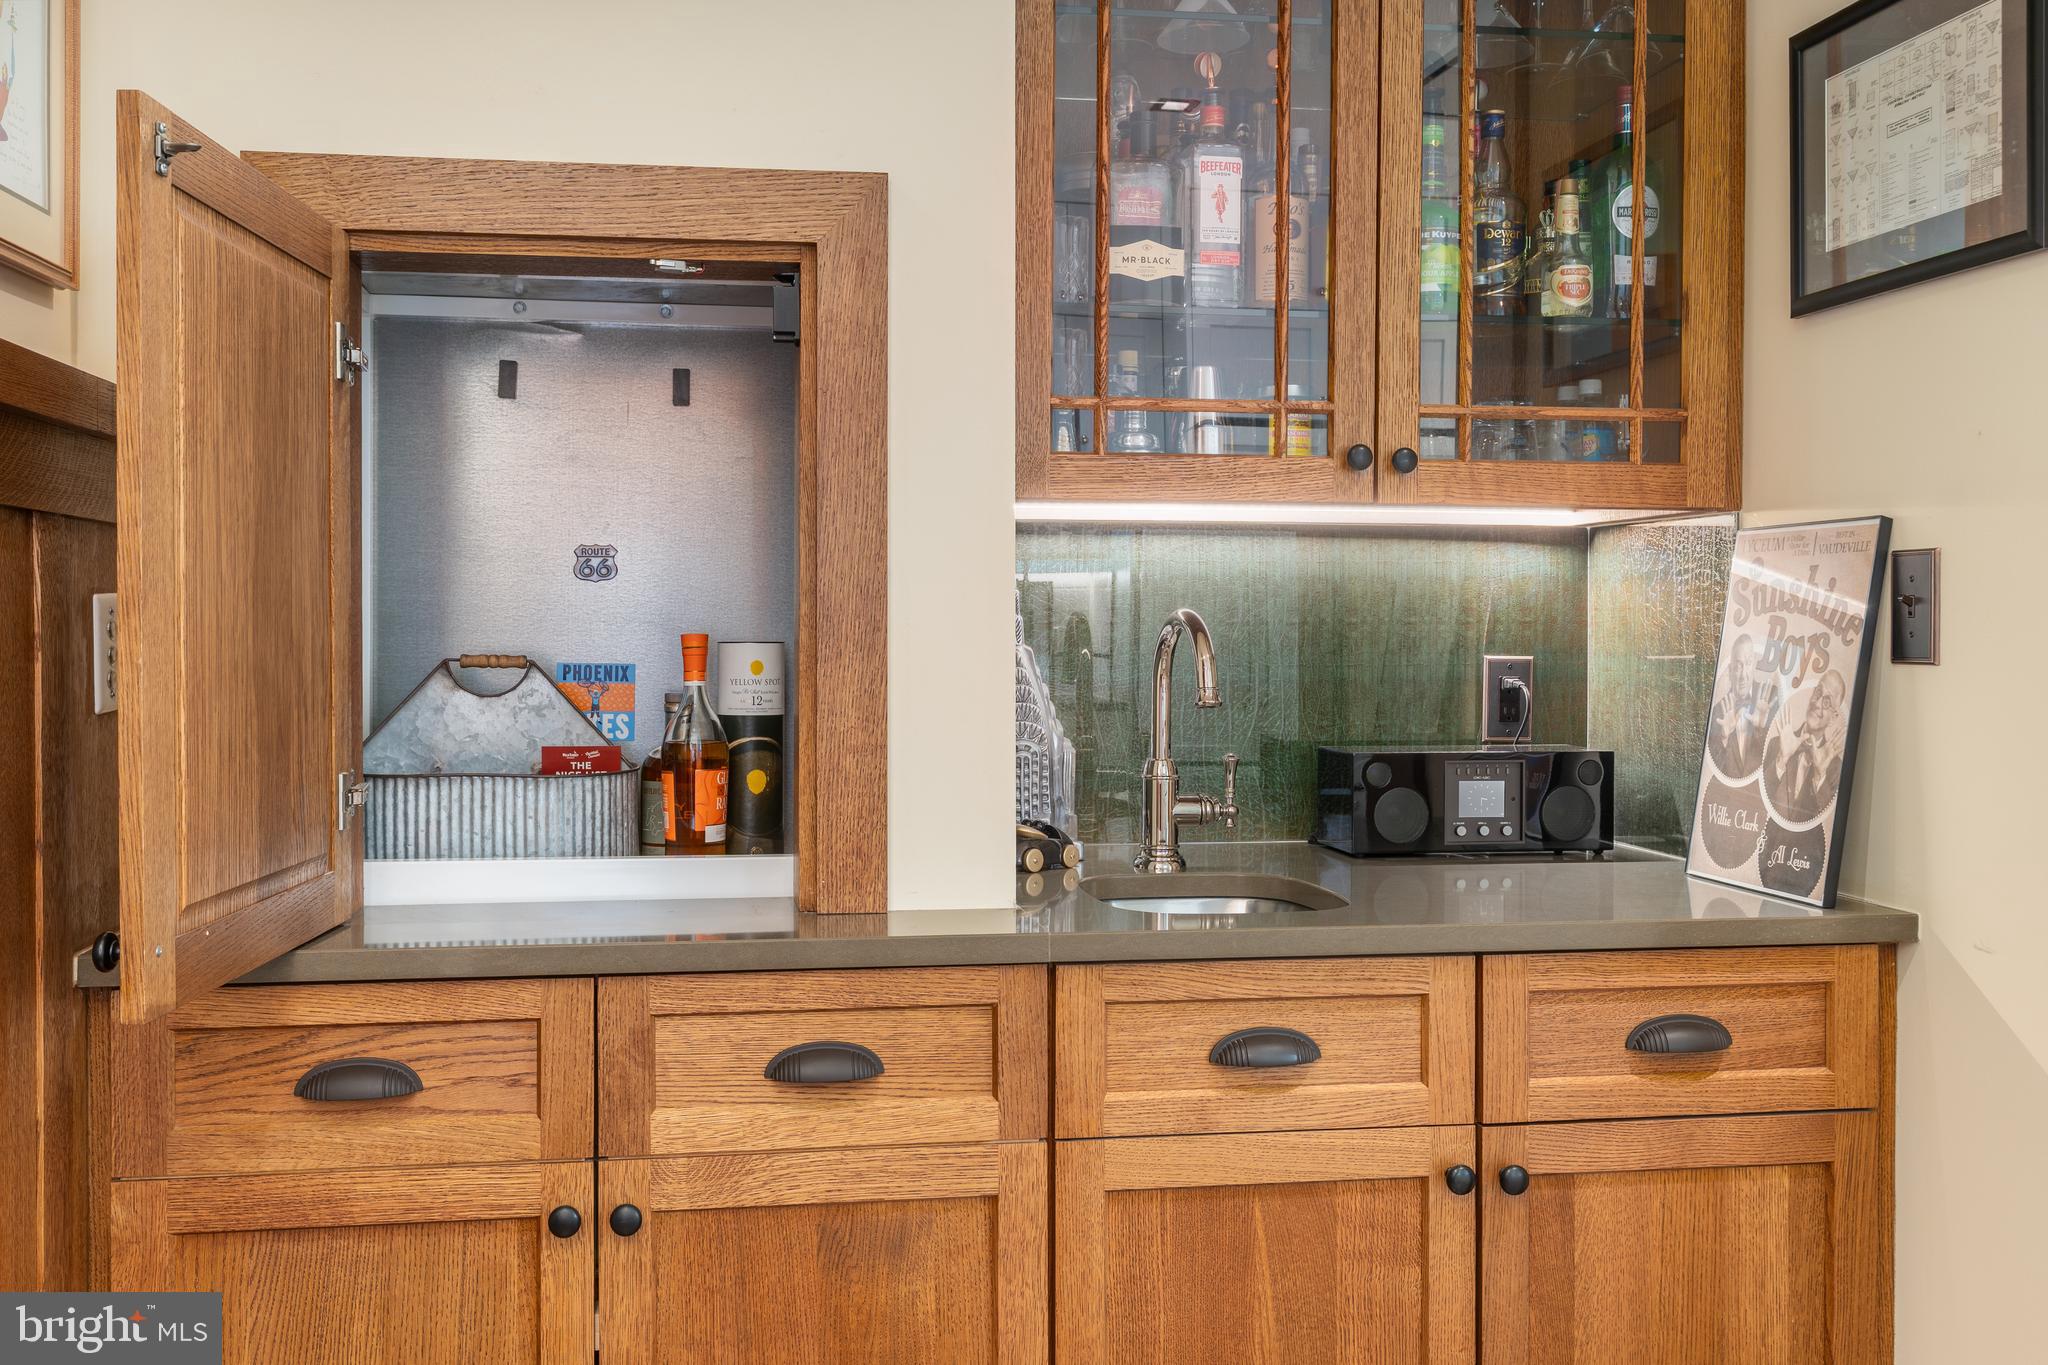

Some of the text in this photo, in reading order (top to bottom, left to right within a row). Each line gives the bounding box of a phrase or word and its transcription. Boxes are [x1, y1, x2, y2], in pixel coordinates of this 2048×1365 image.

[1200, 160, 1242, 175] BEEFEATER
[581, 547, 610, 556] ROUTE
[1818, 541, 1872, 554] VAUDEVILLE
[579, 558, 612, 578] 66
[1755, 615, 1830, 689] Boys
[562, 664, 630, 682] PHOENIX
[730, 678, 780, 686] YELLOW SPOT
[752, 696, 763, 706] 12
[1708, 803, 1759, 832] Willie Clark
[1768, 844, 1811, 871] Al Lewis
